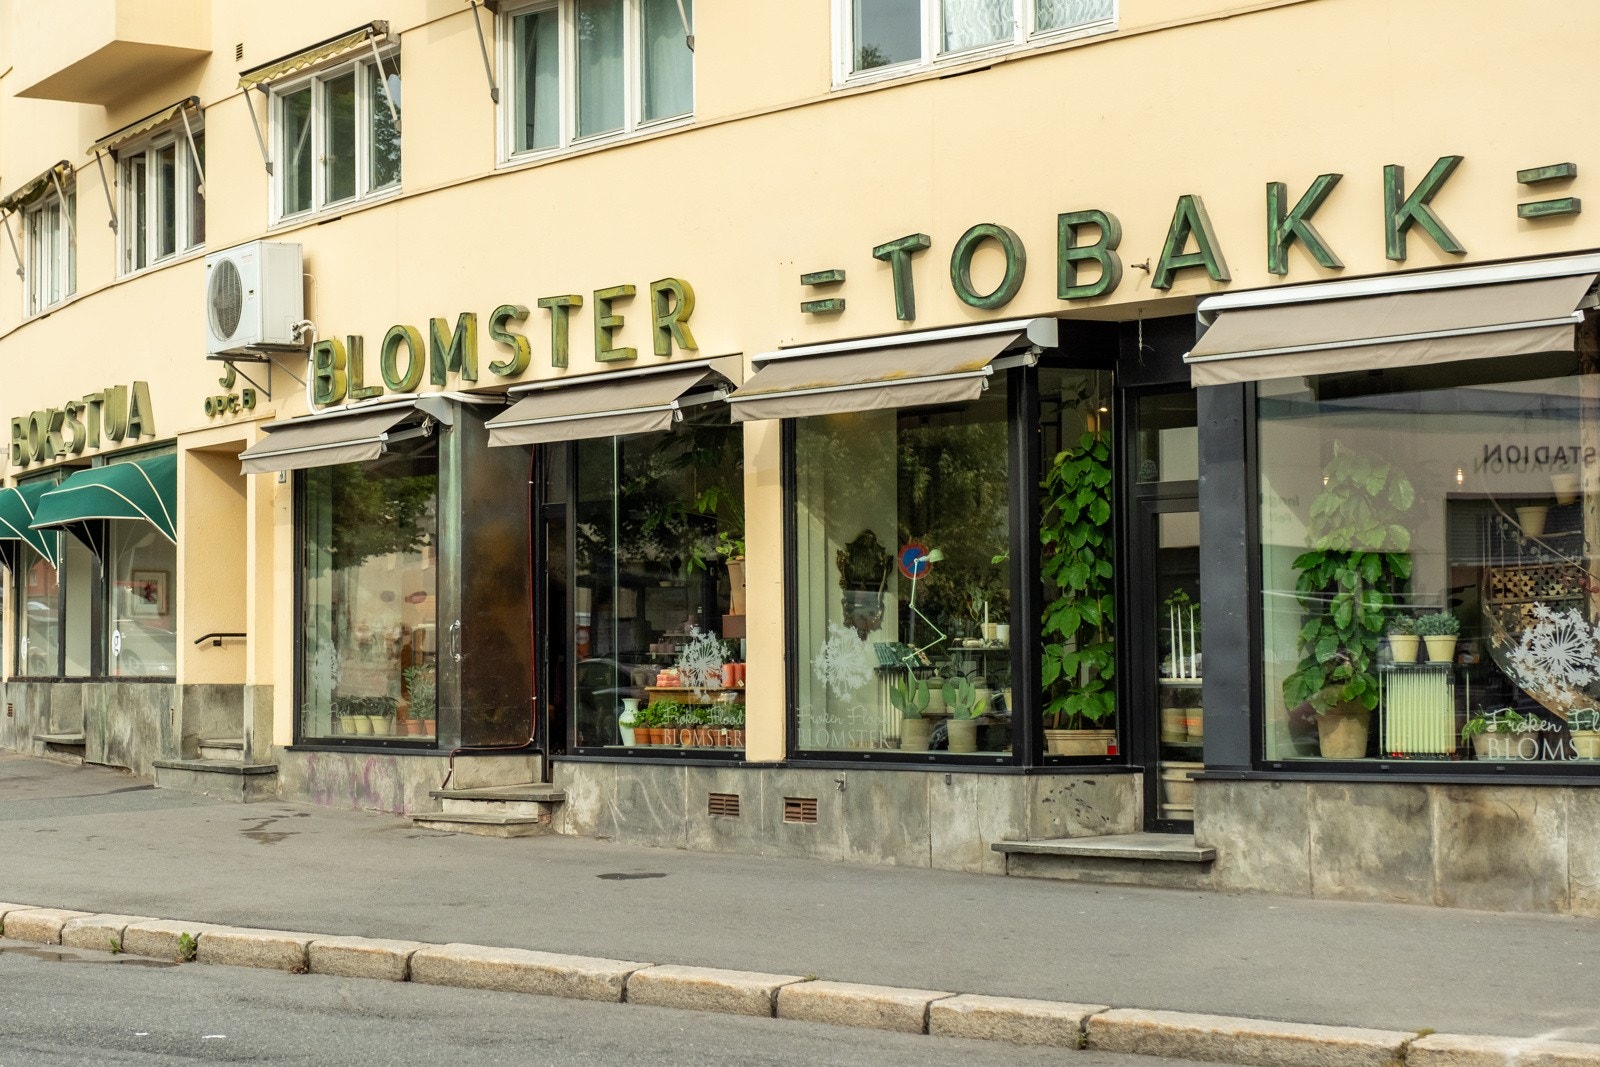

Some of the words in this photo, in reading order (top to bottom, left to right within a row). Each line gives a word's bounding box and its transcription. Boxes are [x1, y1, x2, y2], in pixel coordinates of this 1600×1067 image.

[313, 277, 699, 405] BLOMSTER
[11, 381, 156, 467] BOKSTUA
[1484, 707, 1562, 736] Frøken
[663, 728, 745, 748] BLOMSTER
[797, 728, 892, 750] BLOMSTER
